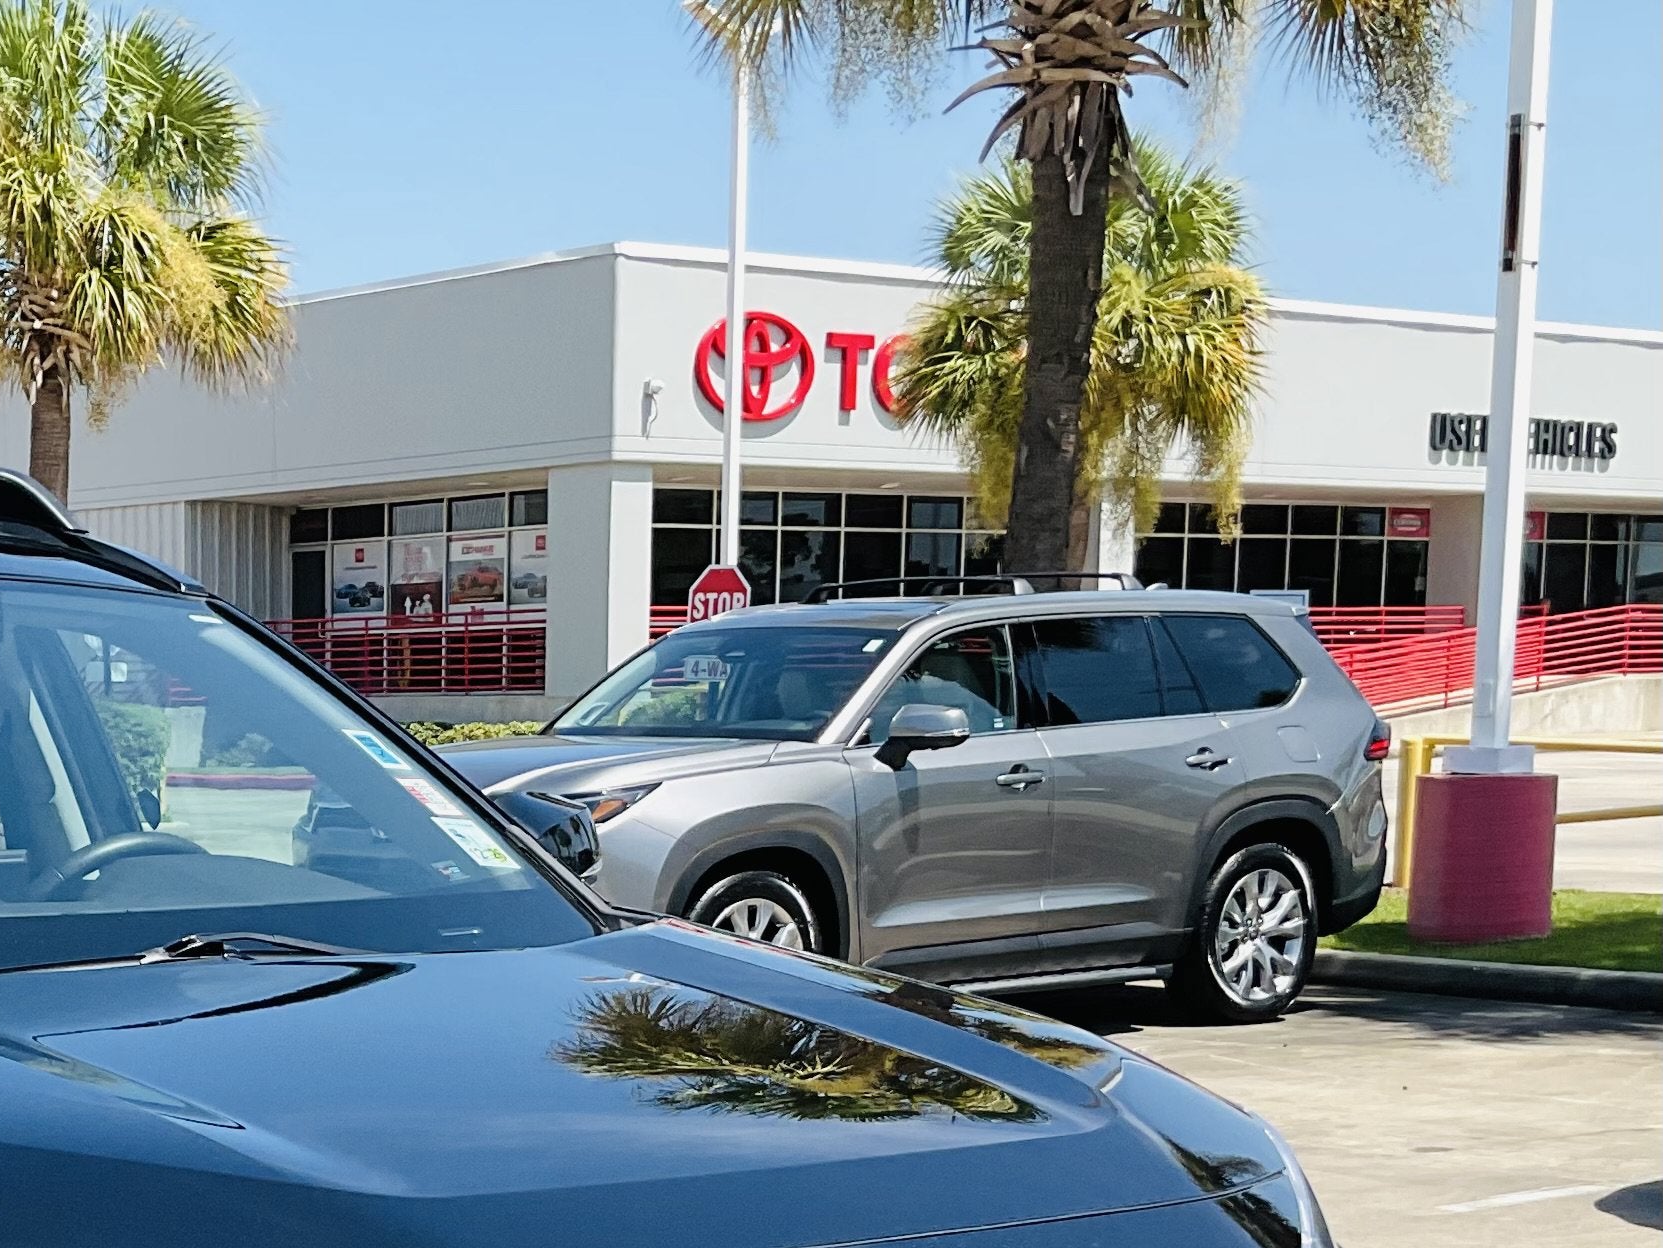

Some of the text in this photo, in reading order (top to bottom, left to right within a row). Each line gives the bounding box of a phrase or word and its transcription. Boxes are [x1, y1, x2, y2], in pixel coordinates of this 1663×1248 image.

[1430, 412, 1617, 460] USE EHICLES
[692, 591, 746, 620] STOP
[690, 659, 728, 678] 4-WA
